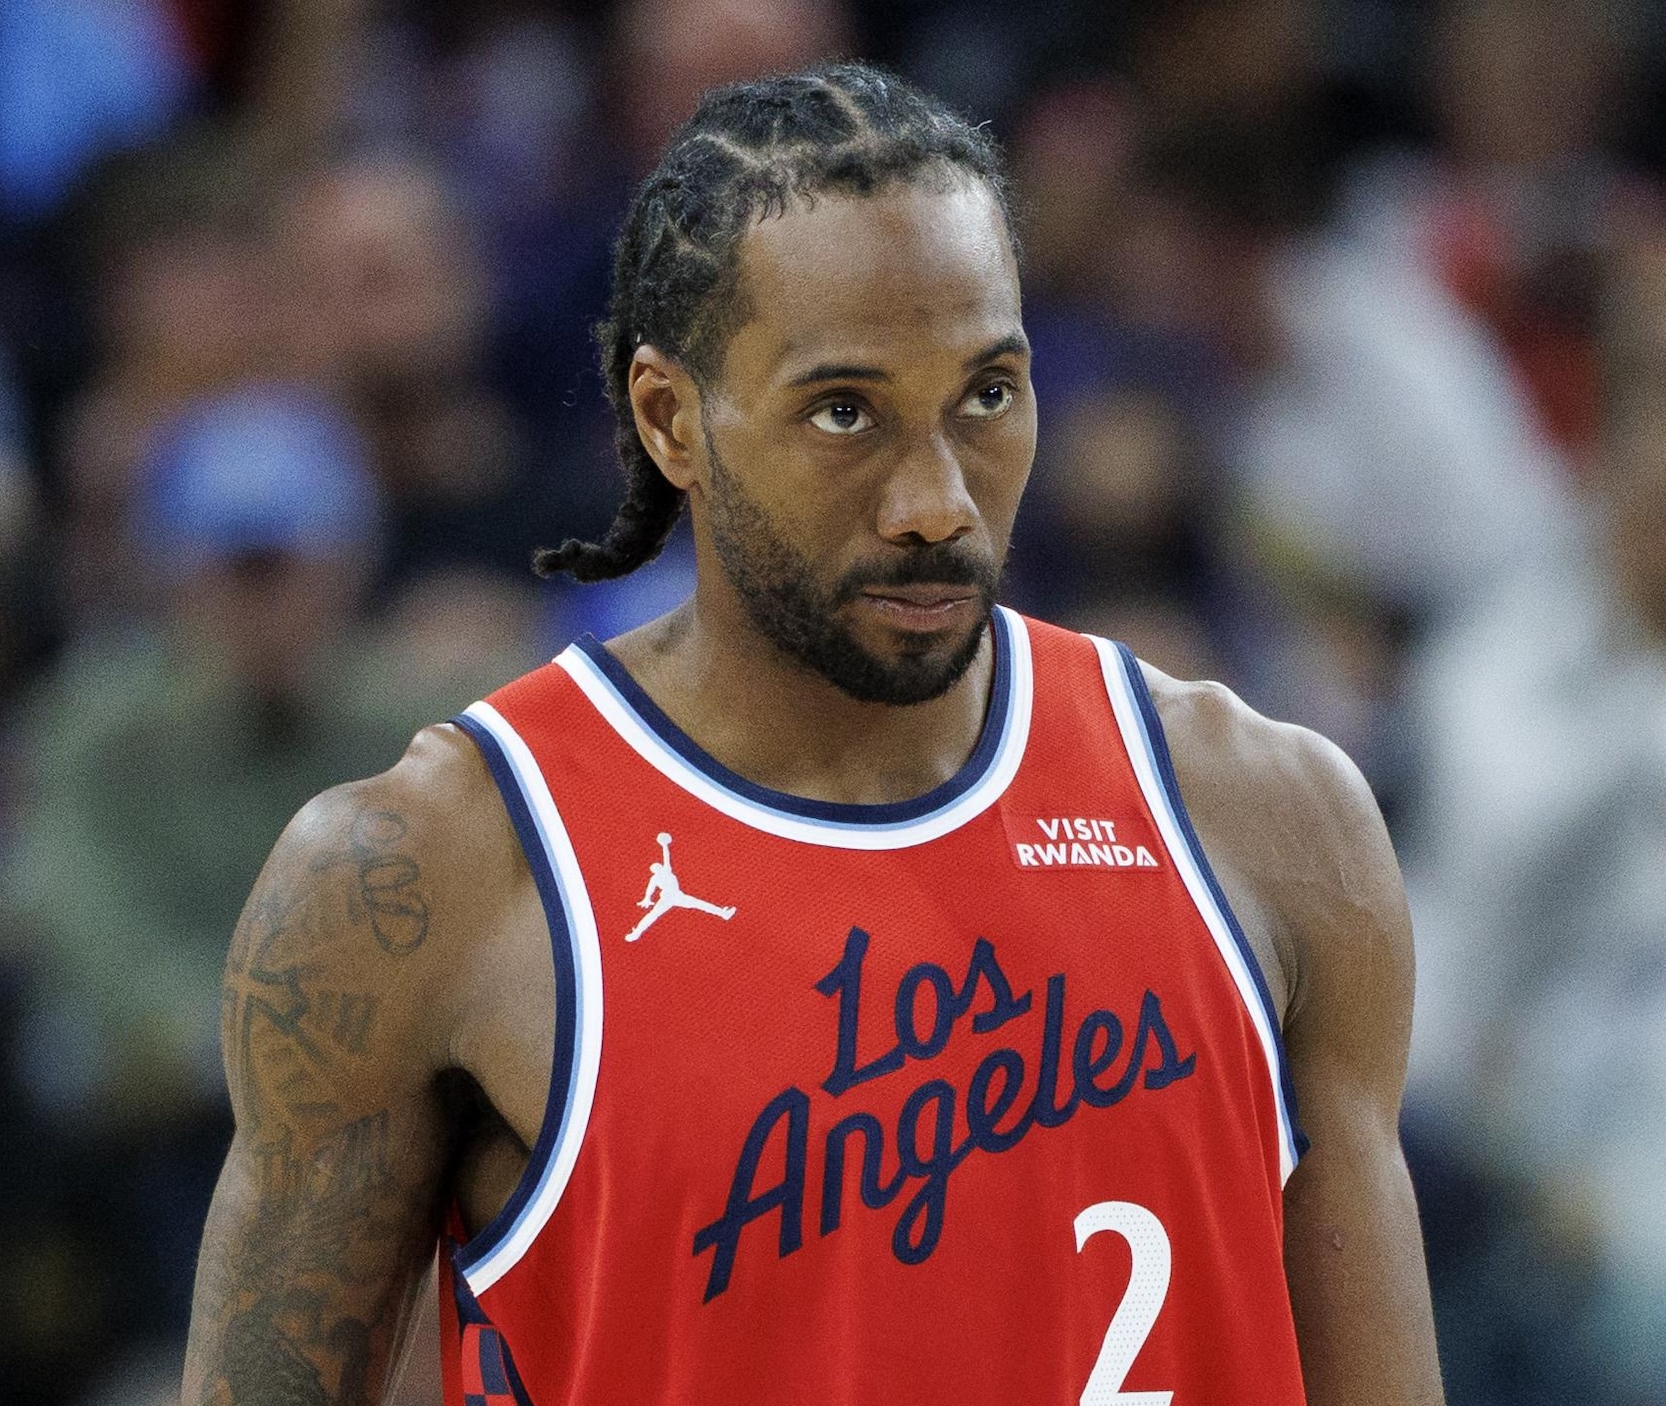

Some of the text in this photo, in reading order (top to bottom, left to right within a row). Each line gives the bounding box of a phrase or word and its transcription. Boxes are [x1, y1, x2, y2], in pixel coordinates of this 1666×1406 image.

[1016, 843, 1159, 867] RWANDA
[1036, 817, 1117, 843] VISIT
[814, 926, 1033, 1099] Los
[692, 973, 1196, 1305] Angeles
